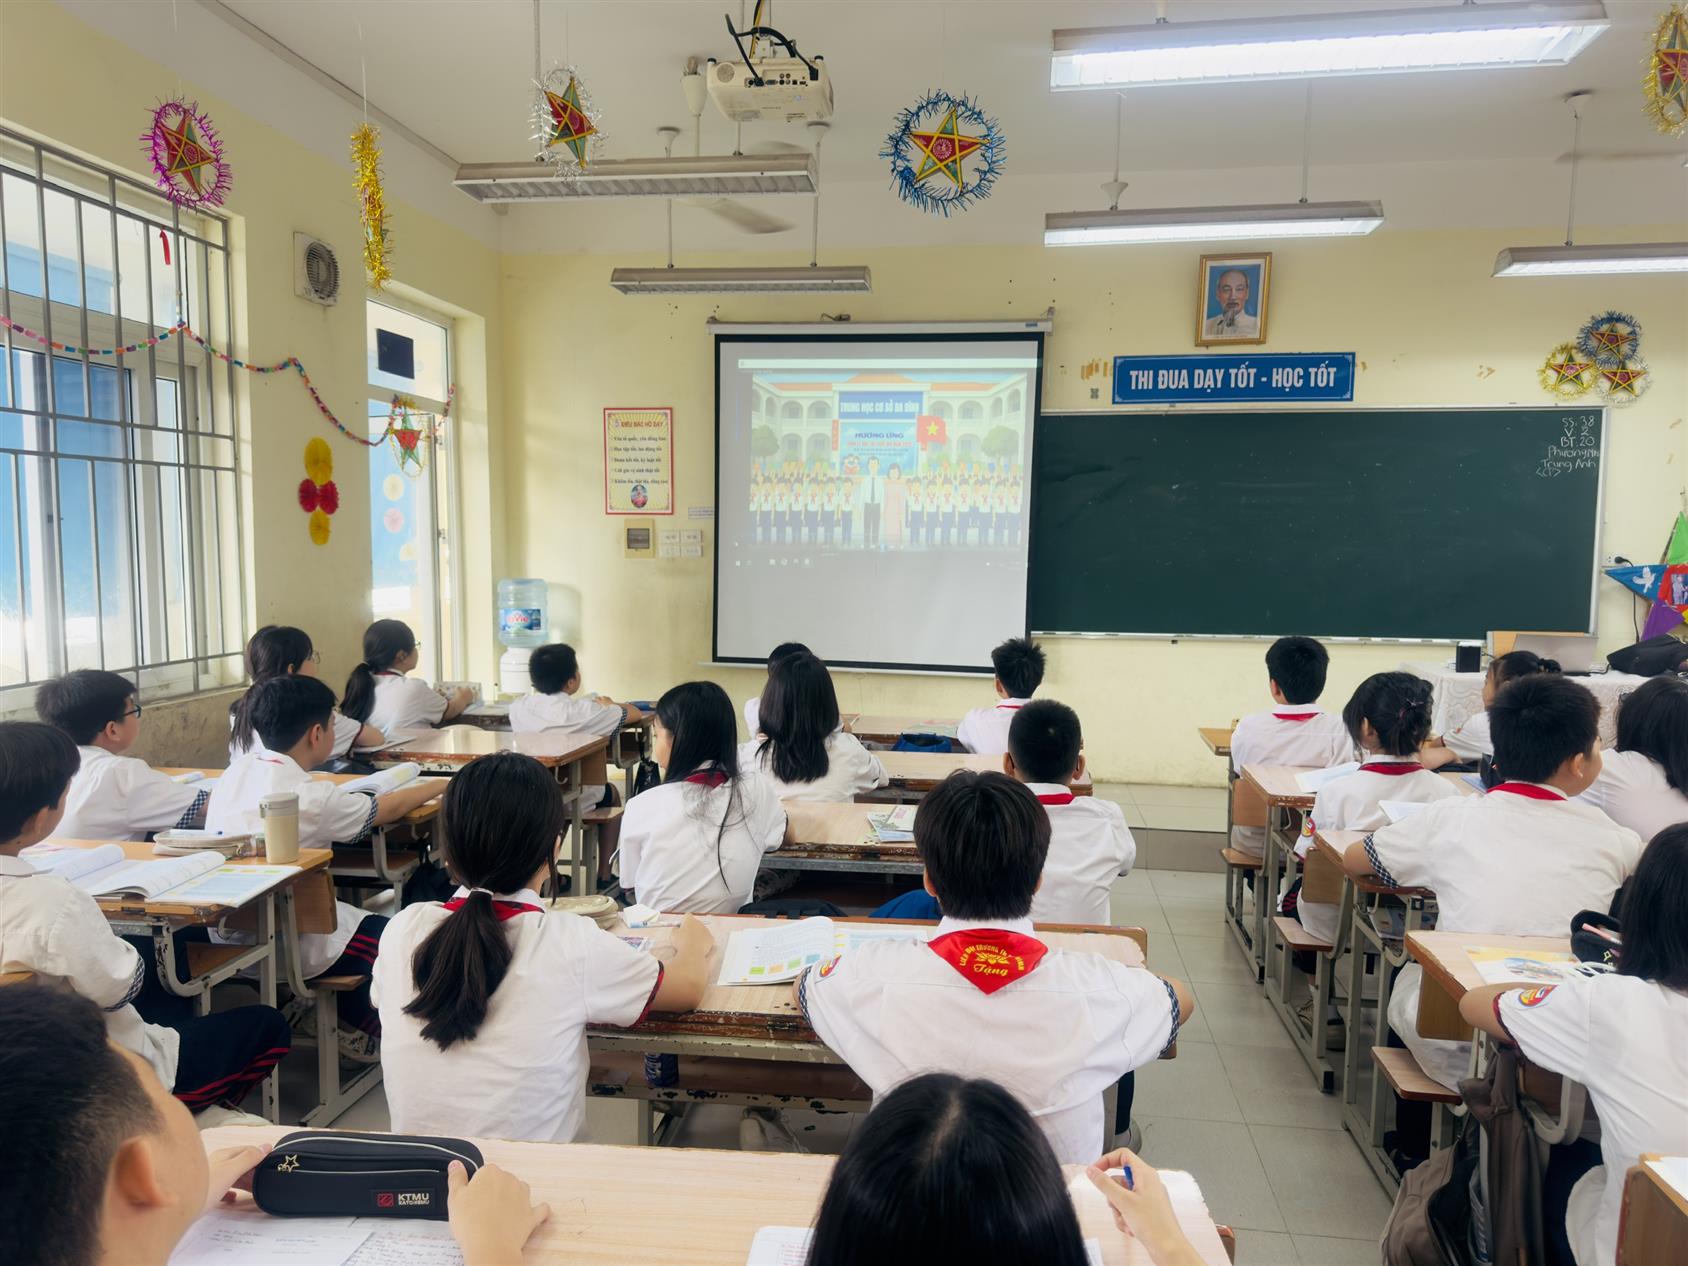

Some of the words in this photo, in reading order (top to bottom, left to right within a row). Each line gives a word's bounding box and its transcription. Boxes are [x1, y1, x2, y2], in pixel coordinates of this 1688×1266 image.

[1129, 369, 1153, 390] THI
[1158, 369, 1189, 389] ĐUA
[1194, 368, 1225, 393] DẠY
[1229, 361, 1257, 389] TỐT
[1272, 367, 1304, 392] HỌC
[1308, 360, 1337, 388] TỐT
[1580, 415, 1595, 427] 38
[1580, 436, 1596, 447] 20
